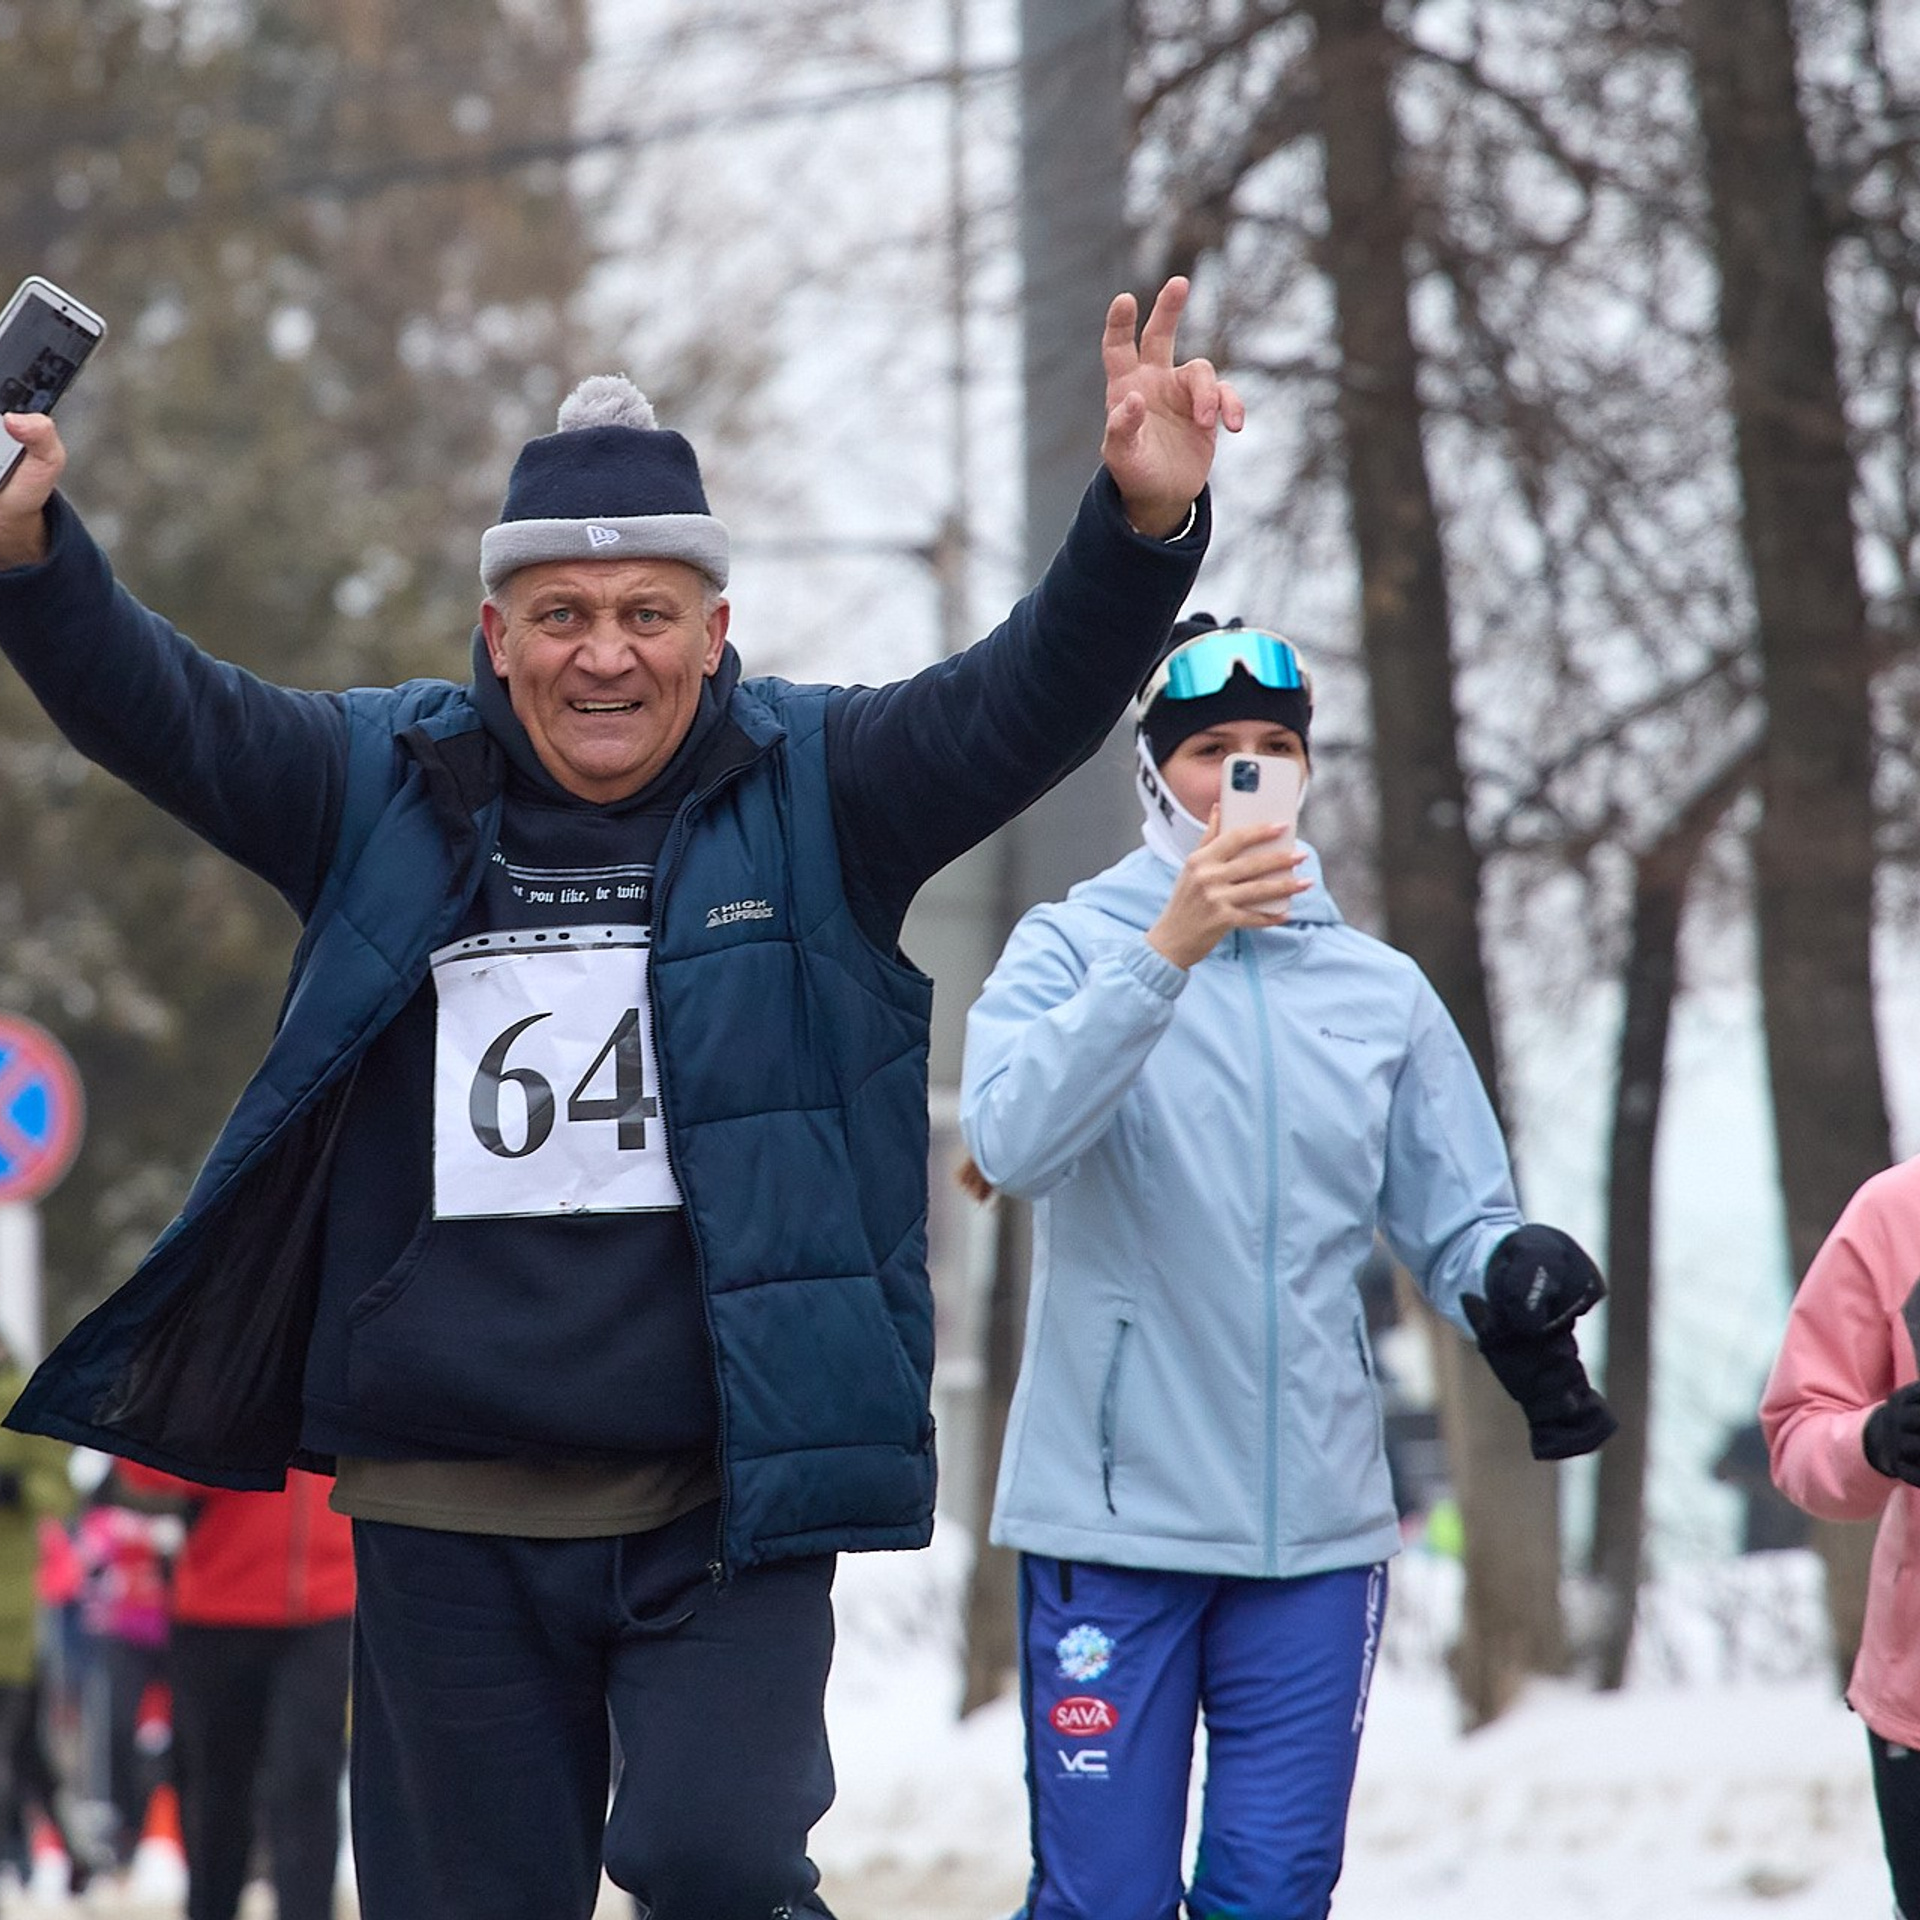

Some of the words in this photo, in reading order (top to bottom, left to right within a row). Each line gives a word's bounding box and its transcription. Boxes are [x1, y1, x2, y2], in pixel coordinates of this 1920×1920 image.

[526, 889, 554, 903] you
[469, 1007, 657, 1159] 64
[1058, 1750, 1108, 1772] VC
